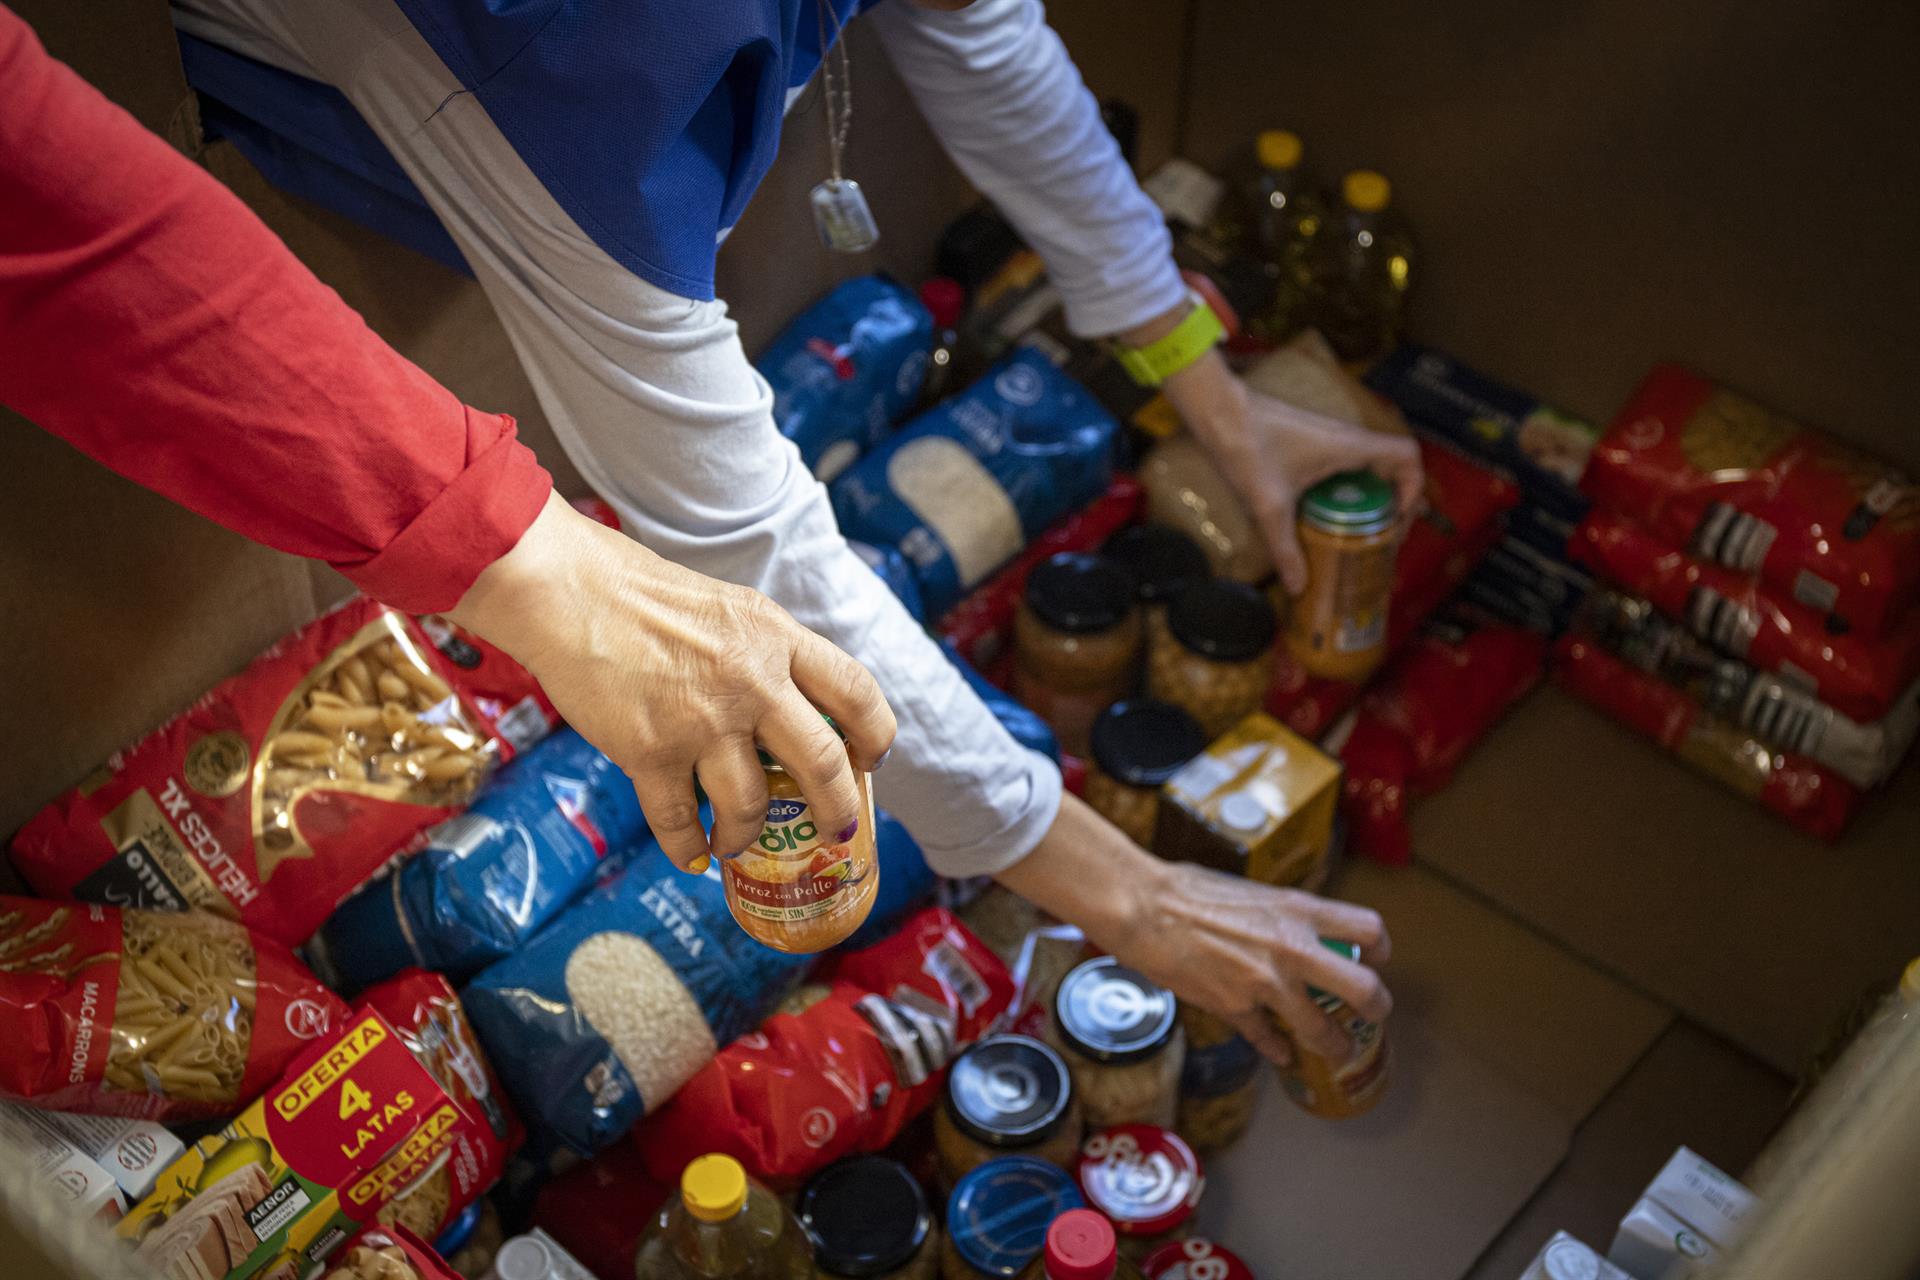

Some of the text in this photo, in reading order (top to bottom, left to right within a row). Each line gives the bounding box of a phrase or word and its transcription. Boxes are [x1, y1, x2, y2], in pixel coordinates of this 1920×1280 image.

[160, 777, 191, 820] XL
[767, 804, 800, 816] ero
[759, 821, 818, 852] olo
[180, 812, 259, 906] HÉLICES
[736, 878, 772, 898] Arroz
[793, 881, 832, 899] Pollo
[639, 887, 705, 959] EXTRA
[788, 908, 805, 919] SIN
[69, 981, 99, 1083] MACARRONS
[280, 1025, 382, 1113] OFERTA
[339, 1079, 372, 1120] 4
[341, 1090, 415, 1159] LATAS
[354, 1113, 455, 1199] OFERTA
[250, 1181, 295, 1224] AENOR
